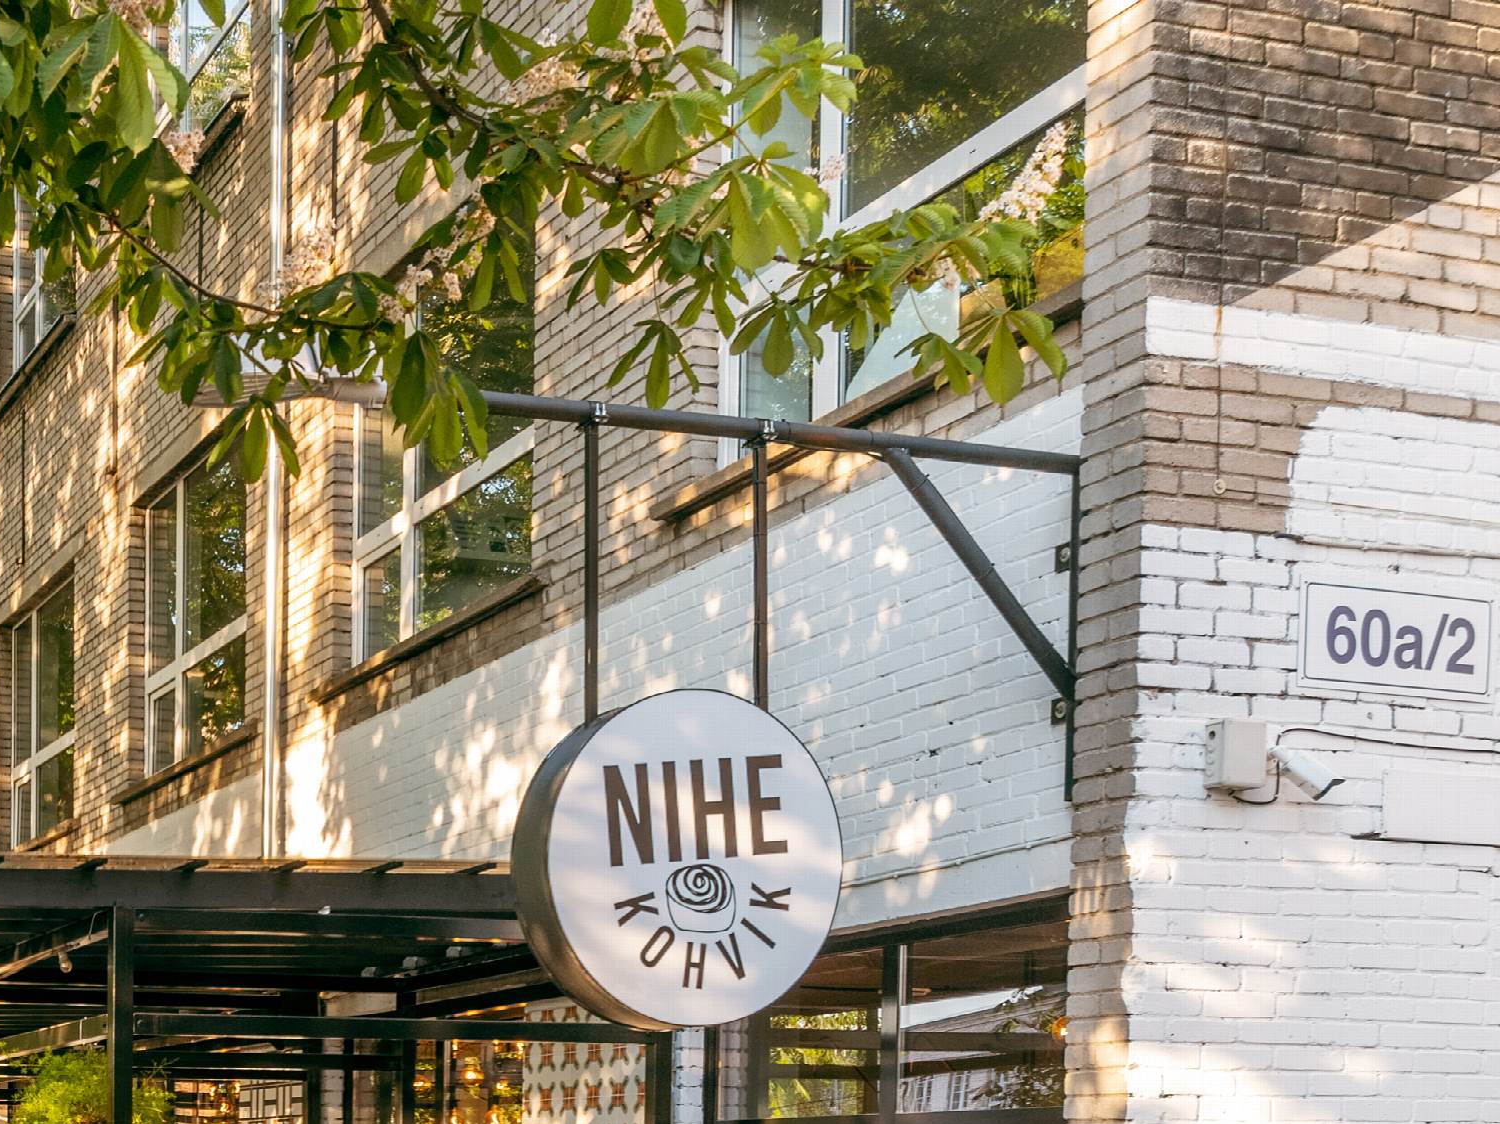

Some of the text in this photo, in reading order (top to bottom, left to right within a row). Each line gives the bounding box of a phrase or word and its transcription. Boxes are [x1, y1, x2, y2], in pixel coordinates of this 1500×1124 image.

[1326, 605, 1475, 675] 60a/2
[603, 753, 788, 867] NIHE
[613, 882, 791, 989] KOHVIK
